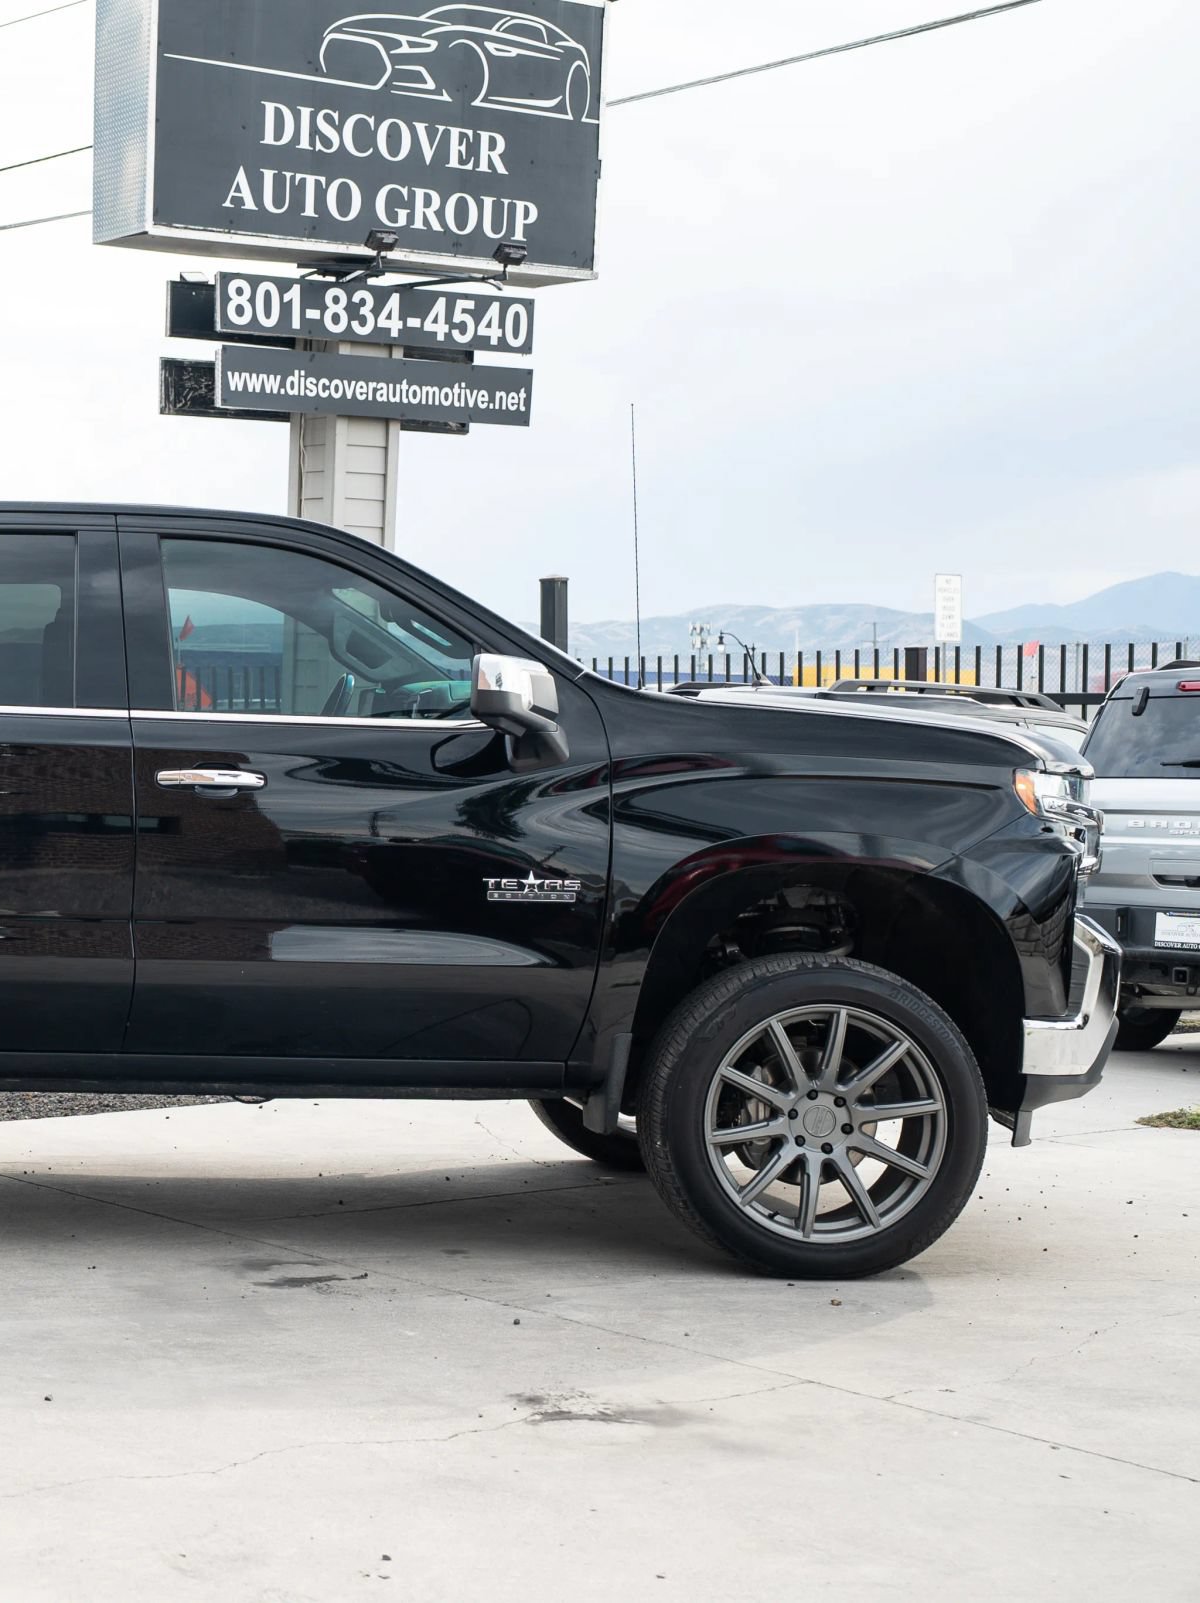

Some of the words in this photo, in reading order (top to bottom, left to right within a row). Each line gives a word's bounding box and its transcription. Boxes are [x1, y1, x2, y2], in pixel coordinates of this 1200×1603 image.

[260, 101, 508, 174] DISCOVER
[222, 166, 362, 221] AUTO
[375, 183, 538, 241] GROUP
[227, 278, 528, 348] 801-834-4540
[227, 369, 527, 412] www.discoverautomotive.net
[1127, 819, 1200, 829] BRO
[1154, 941, 1182, 949] DISCOVER
